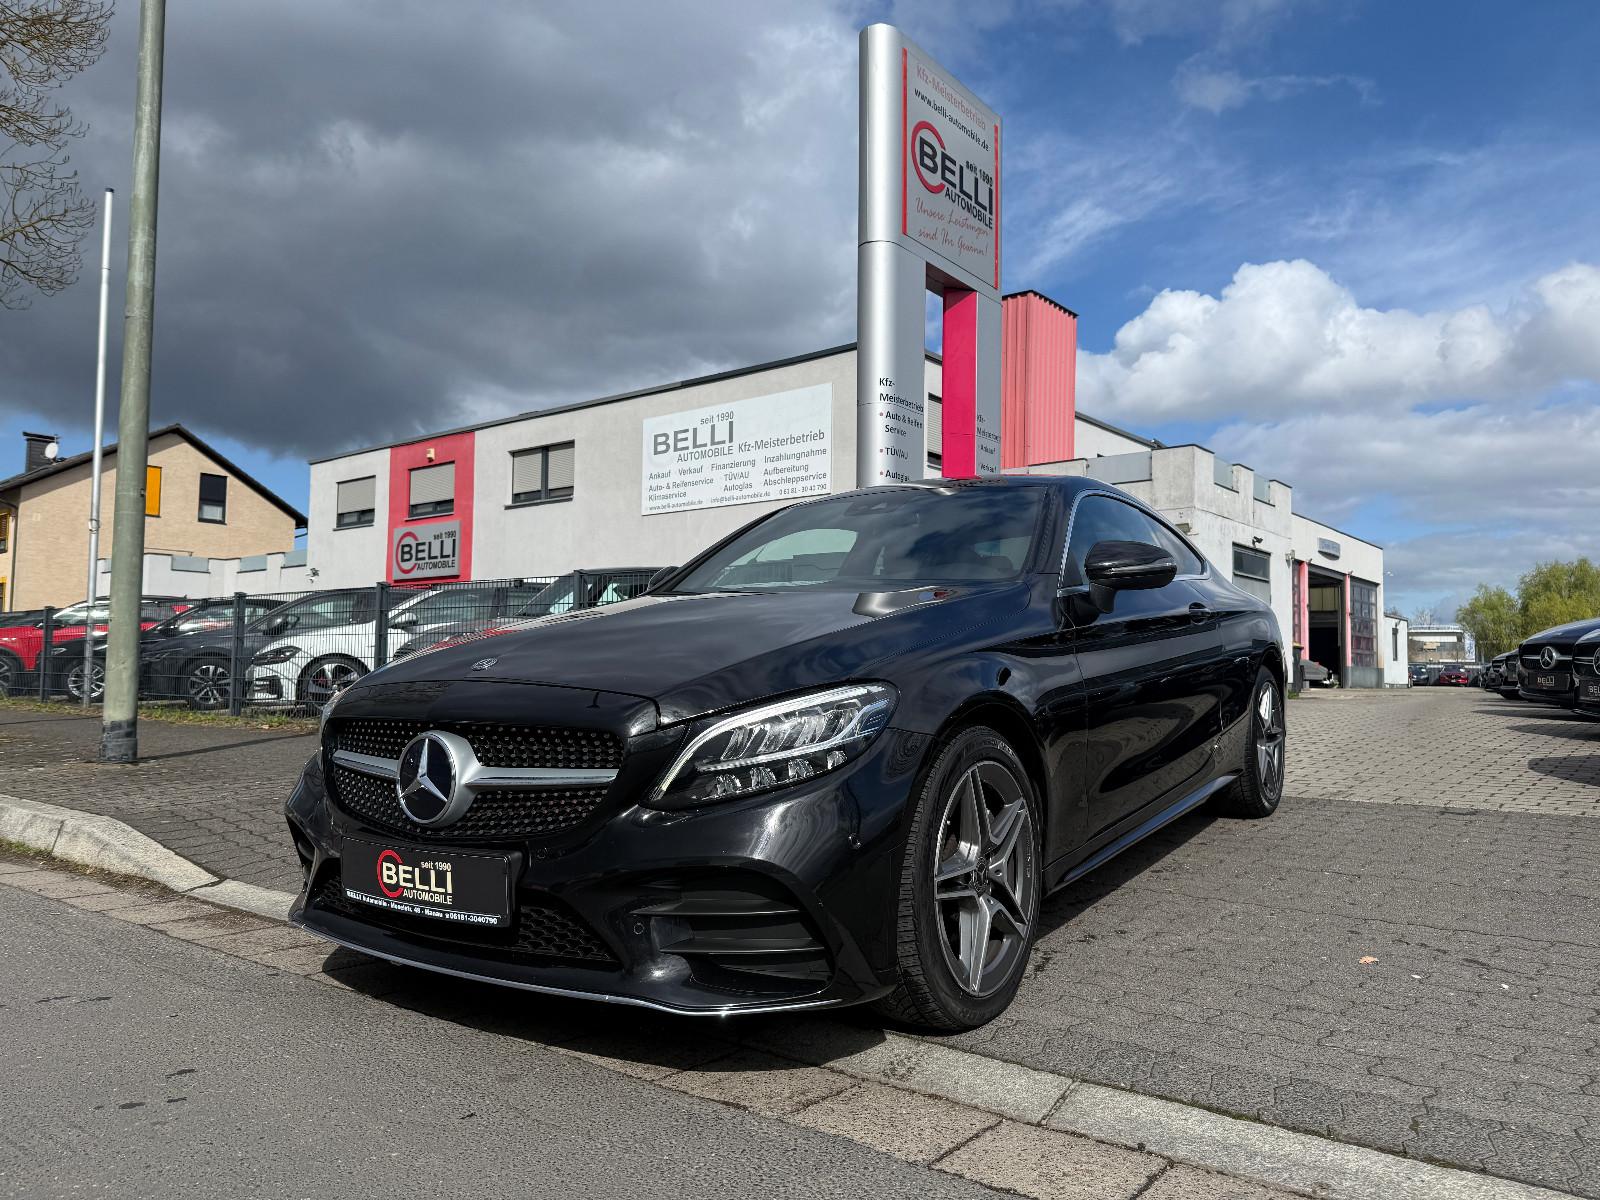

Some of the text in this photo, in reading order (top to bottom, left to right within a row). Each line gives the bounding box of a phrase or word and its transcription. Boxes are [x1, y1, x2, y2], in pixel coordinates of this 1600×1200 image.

[916, 65, 986, 131] Kfz-Meisterbetrieb
[914, 87, 990, 152] www.belli-automobile.de
[920, 135, 994, 216] BELLI
[965, 160, 994, 188] seit 1990
[915, 196, 989, 239] Unsere Leistungen
[944, 186, 993, 230] AUTOMOBILE
[918, 226, 938, 241] sind
[941, 227, 955, 247] Ihr
[880, 377, 896, 387] Kfz-
[880, 392, 924, 413] Meisterbetrieb
[700, 410, 734, 425] seit 1990
[885, 410, 901, 422] Auto
[902, 414, 907, 423] &
[653, 420, 734, 456] BELLI
[738, 429, 825, 454] Kfz-Meisterbetrieb
[885, 424, 907, 438] Service
[648, 447, 827, 481] Ankauf Verkauf Finanzierung Inzahlungnahme
[677, 445, 734, 463] AUTOMOBILE
[648, 464, 809, 493] Auto- & Reifenservice TÜV/AU Aufbereitung
[648, 472, 827, 502] Klimaservice Autoglas Abschleppservice
[444, 530, 456, 539] 1990
[401, 538, 456, 563] BELLI
[417, 560, 456, 570] AUTOMOBILE
[382, 861, 453, 894] BELLI
[420, 860, 451, 871] seit 1990
[403, 889, 453, 905] AUTOMOBILE
